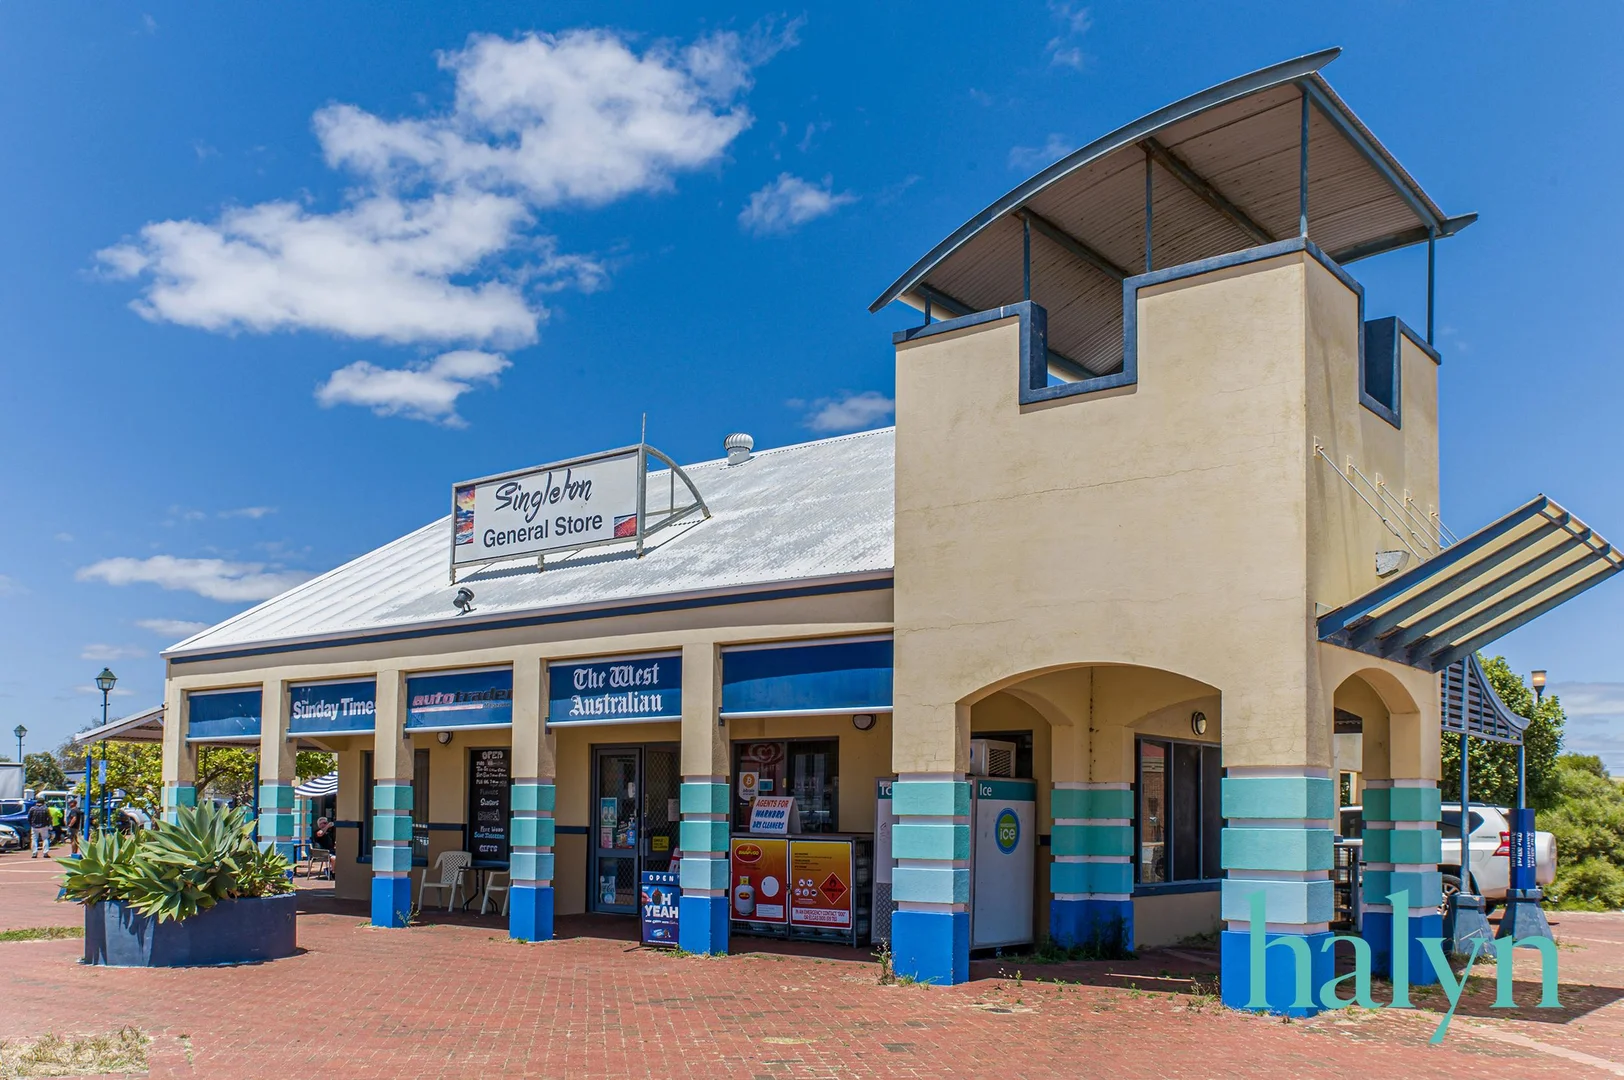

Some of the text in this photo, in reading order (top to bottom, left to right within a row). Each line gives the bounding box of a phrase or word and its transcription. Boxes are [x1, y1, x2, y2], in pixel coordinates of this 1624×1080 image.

[494, 468, 592, 524] Singleton
[483, 514, 603, 548] General Store
[573, 662, 660, 690] The West
[293, 699, 339, 721] Sunday
[568, 692, 664, 717] Australian
[979, 783, 992, 796] Ice
[756, 799, 777, 808] AGENTS
[778, 800, 789, 808] FOR
[762, 821, 785, 830] CLEANERS
[1000, 828, 1016, 841] ice
[648, 874, 674, 882] OPEN
[645, 905, 679, 919] YEAH
